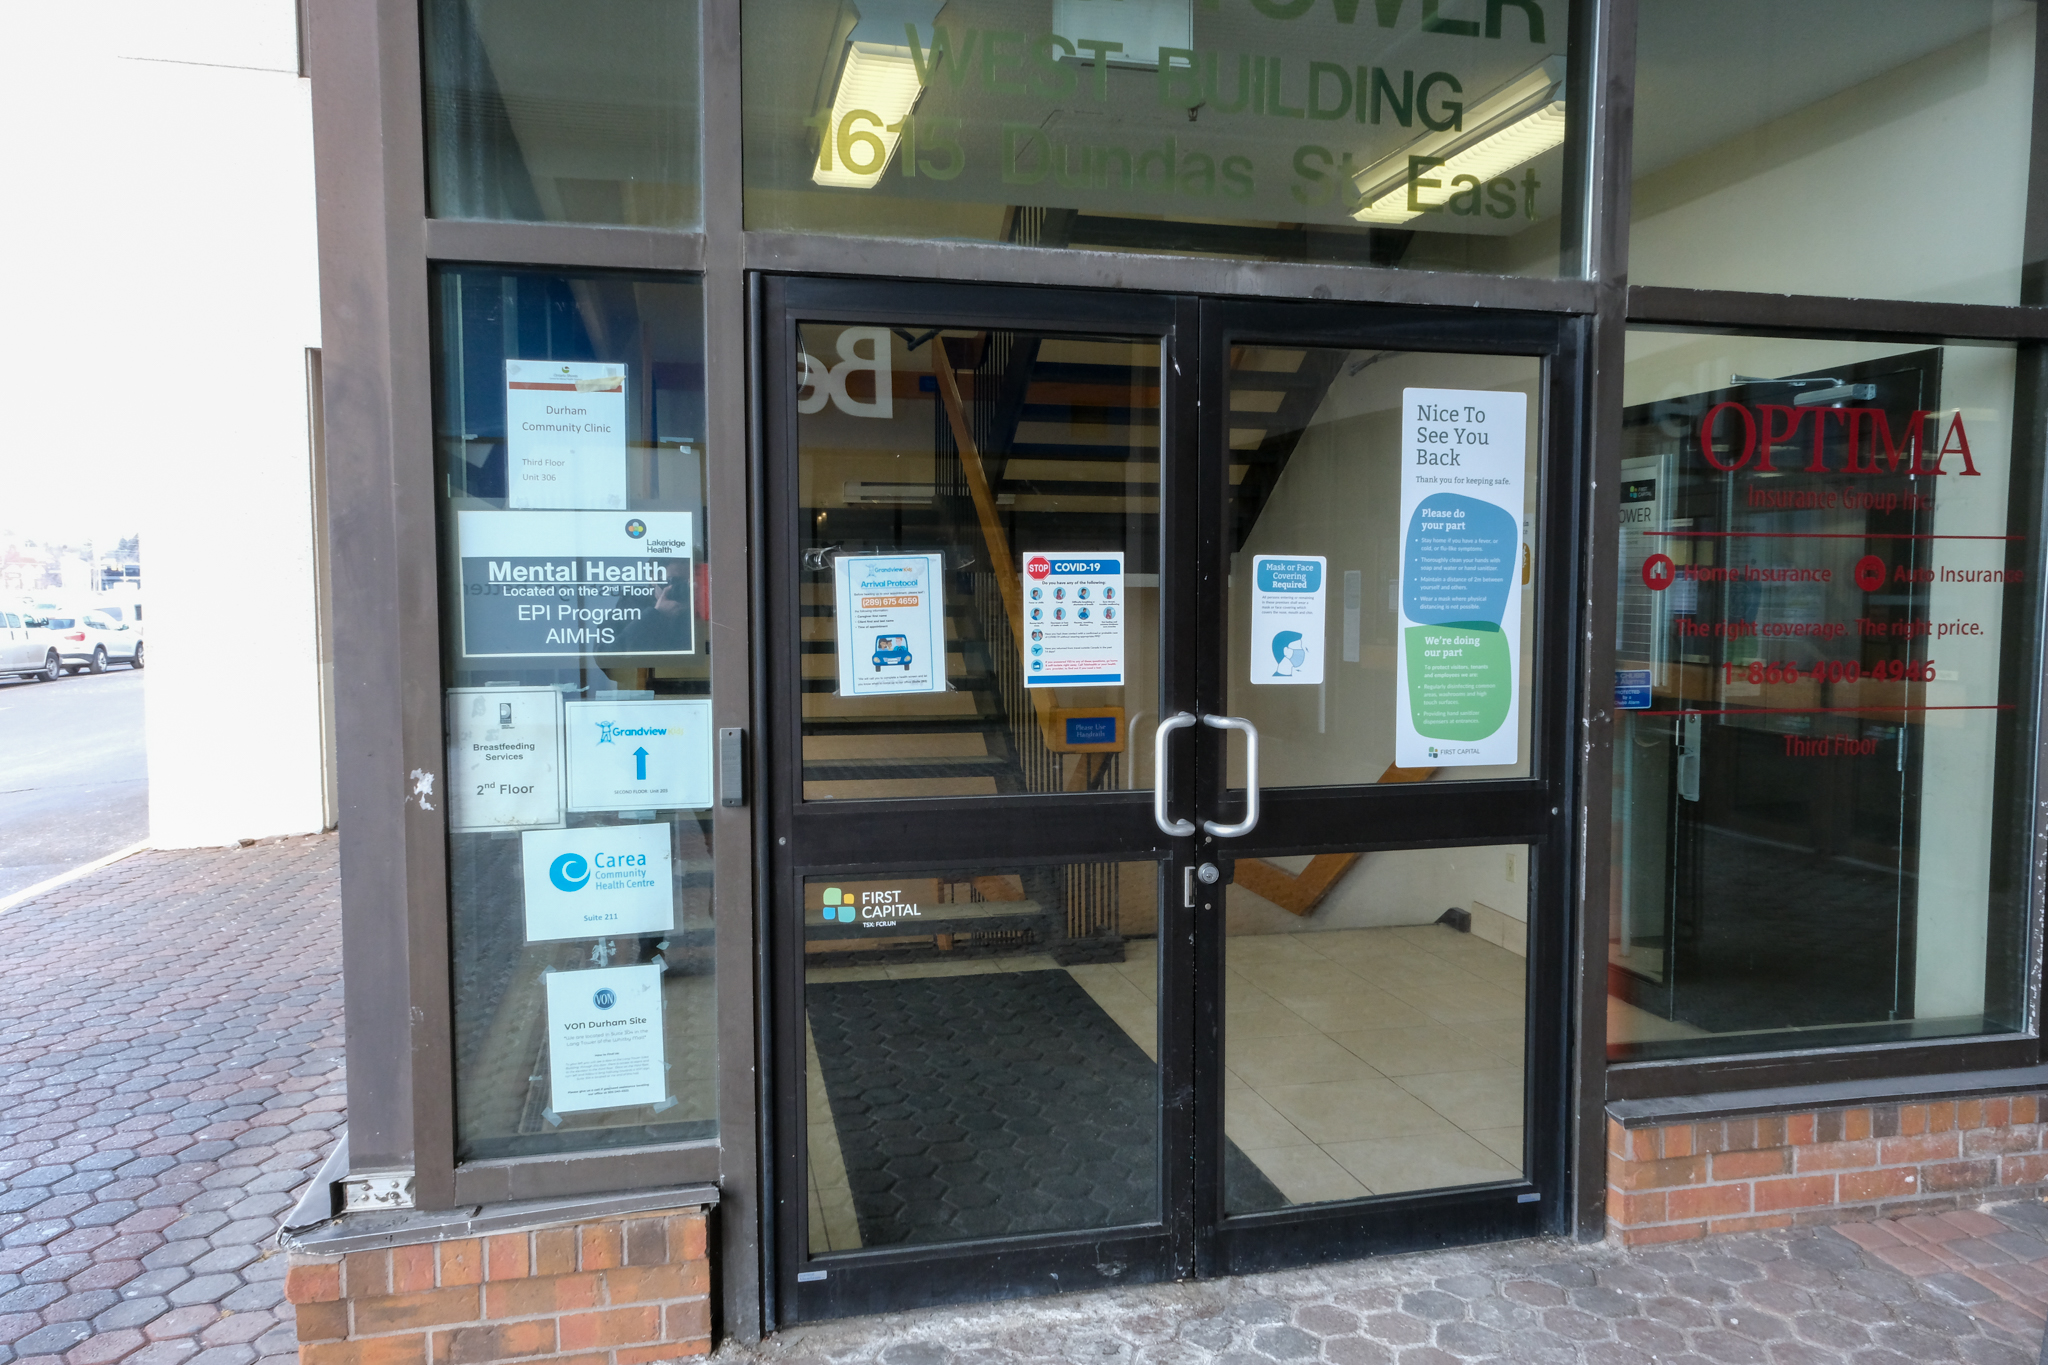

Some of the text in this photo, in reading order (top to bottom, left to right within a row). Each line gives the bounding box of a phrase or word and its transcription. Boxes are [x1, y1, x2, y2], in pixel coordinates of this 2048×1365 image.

[904, 23, 1463, 131] WEST BUILDING
[805, 108, 964, 181] 1615
[1003, 123, 1255, 198] Dundas
[1407, 154, 1541, 221] East
[546, 405, 587, 415] Durham
[1417, 404, 1486, 423] Nice To
[522, 422, 611, 434] Community Clinic
[1417, 427, 1489, 445] See You
[1700, 401, 1981, 476] OPTIMA
[545, 459, 565, 467] Floor
[1416, 448, 1460, 466] Back
[1466, 477, 1494, 486] keeping
[1748, 484, 1837, 509] Insurance
[1843, 486, 1897, 515] Group
[1422, 508, 1465, 518] Please do
[1422, 522, 1466, 532] your part
[646, 539, 686, 548] Lakeridge
[488, 561, 667, 582] Mental Health
[1029, 563, 1100, 572] STOP COVID-19
[1684, 564, 1832, 582] Home Insurance
[1272, 572, 1306, 581] Covering
[1894, 565, 2024, 583] Auto Insurance
[503, 585, 555, 597] Located
[559, 588, 574, 597] on
[578, 585, 598, 597] the
[623, 585, 654, 597] Floor
[1272, 581, 1307, 590] Required
[862, 598, 882, 607] (289)
[518, 604, 641, 624] EPI Program
[1675, 618, 1984, 641] The right coverage. The right price.
[546, 628, 615, 644] AIMHS
[1454, 636, 1480, 647] doing
[1442, 648, 1462, 658] part
[1723, 660, 1936, 685] 1-866-400-4946
[612, 727, 667, 736] Grandview
[473, 742, 535, 752] Breastfeeding
[1784, 734, 1877, 757] Third Floor
[485, 752, 524, 761] Services
[499, 783, 535, 795] Floor
[594, 852, 646, 868] Carea
[595, 868, 646, 879] Community
[595, 879, 655, 890] Health Centre
[862, 890, 901, 904] FIRST
[862, 904, 922, 918] CAPITAL
[596, 993, 613, 1005] VON
[564, 1022, 586, 1030] VON
[588, 1020, 626, 1028] Durham
